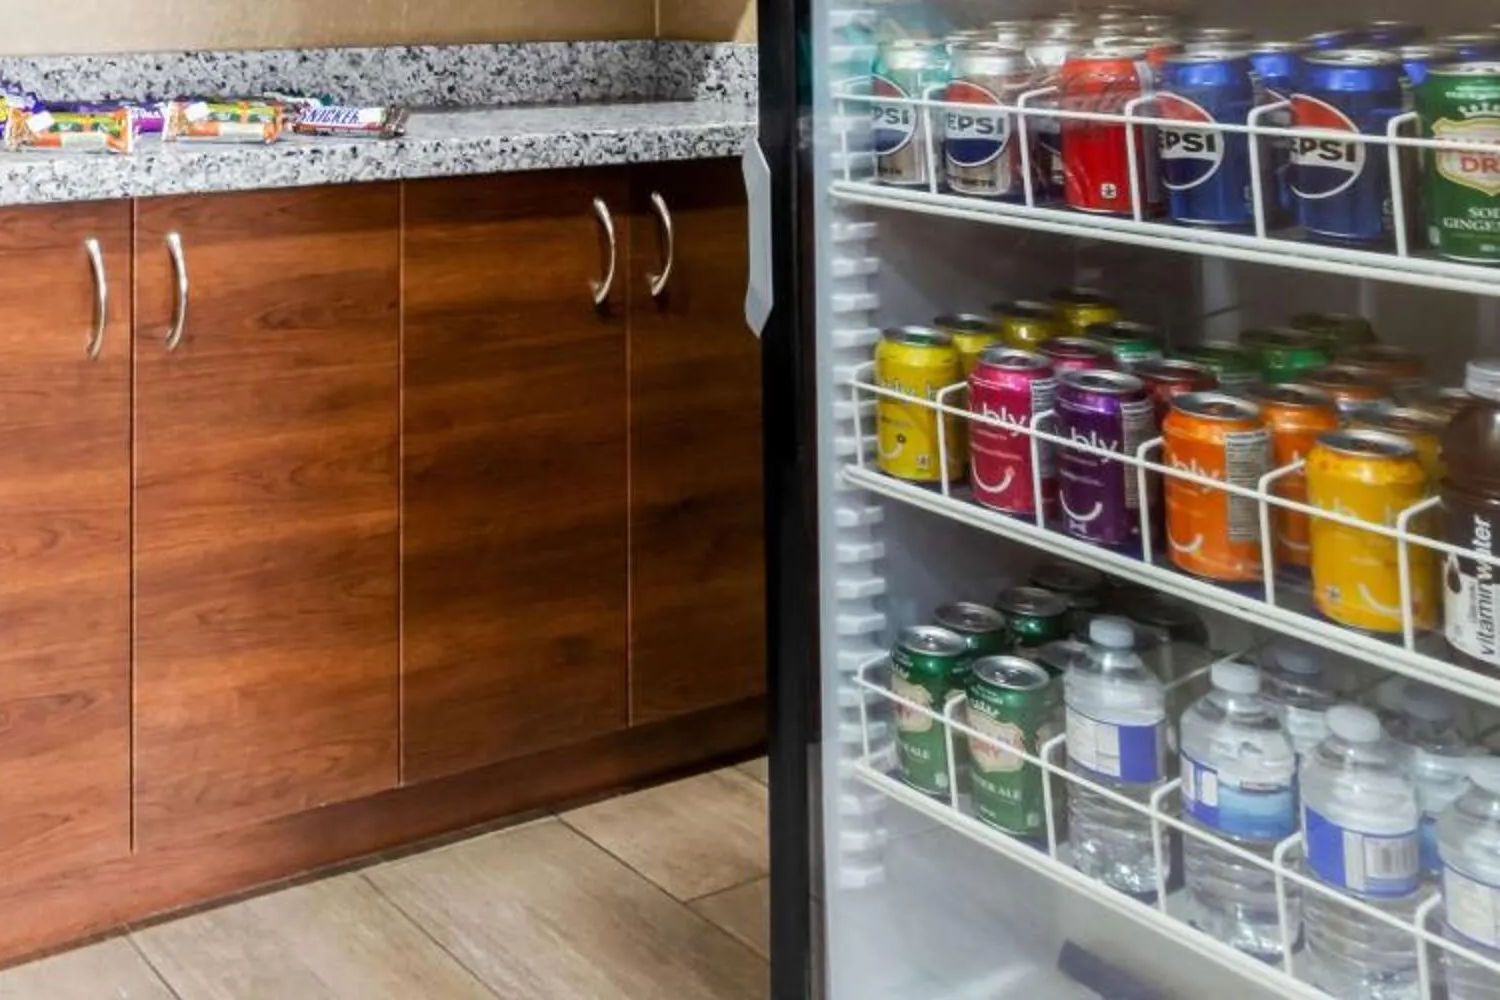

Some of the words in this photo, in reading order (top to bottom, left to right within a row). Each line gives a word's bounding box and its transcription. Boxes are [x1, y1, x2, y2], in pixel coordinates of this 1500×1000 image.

[873, 105, 909, 125] PSI
[947, 111, 1005, 135] EPSI
[1158, 129, 1217, 153] EPSI
[1291, 136, 1356, 163] PSI
[1460, 156, 1500, 174] DR
[983, 401, 1027, 438] bly
[1071, 425, 1118, 464] bly
